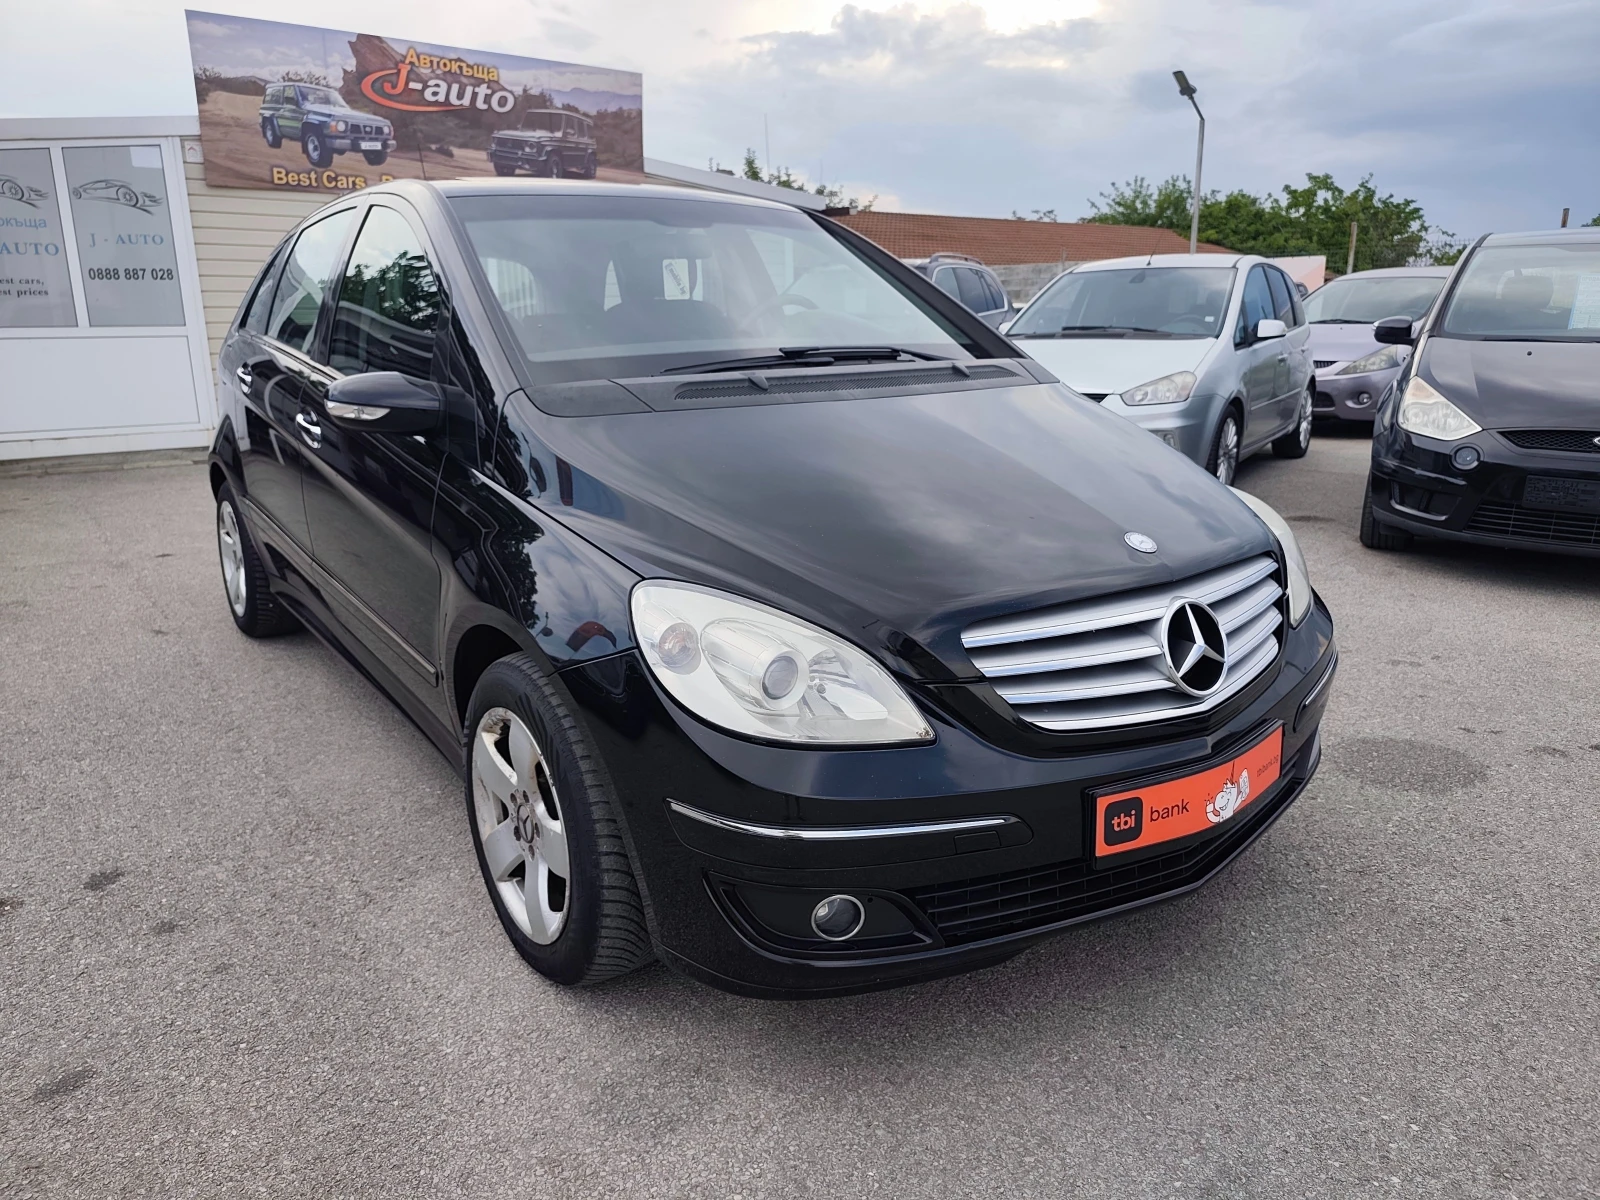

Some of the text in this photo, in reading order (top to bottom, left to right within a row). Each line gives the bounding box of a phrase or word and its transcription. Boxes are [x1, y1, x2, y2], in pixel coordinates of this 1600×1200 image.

[404, 48, 498, 82] Автокъща
[384, 63, 515, 113] J-auto
[272, 167, 318, 187] Best
[322, 171, 366, 190] Cars
[0, 242, 60, 256] AUTO
[89, 232, 96, 248] J
[115, 234, 164, 246] AUTO
[88, 267, 174, 281] 0888 887 028
[16, 287, 49, 298] prices
[1111, 798, 1190, 832] tbi bank
